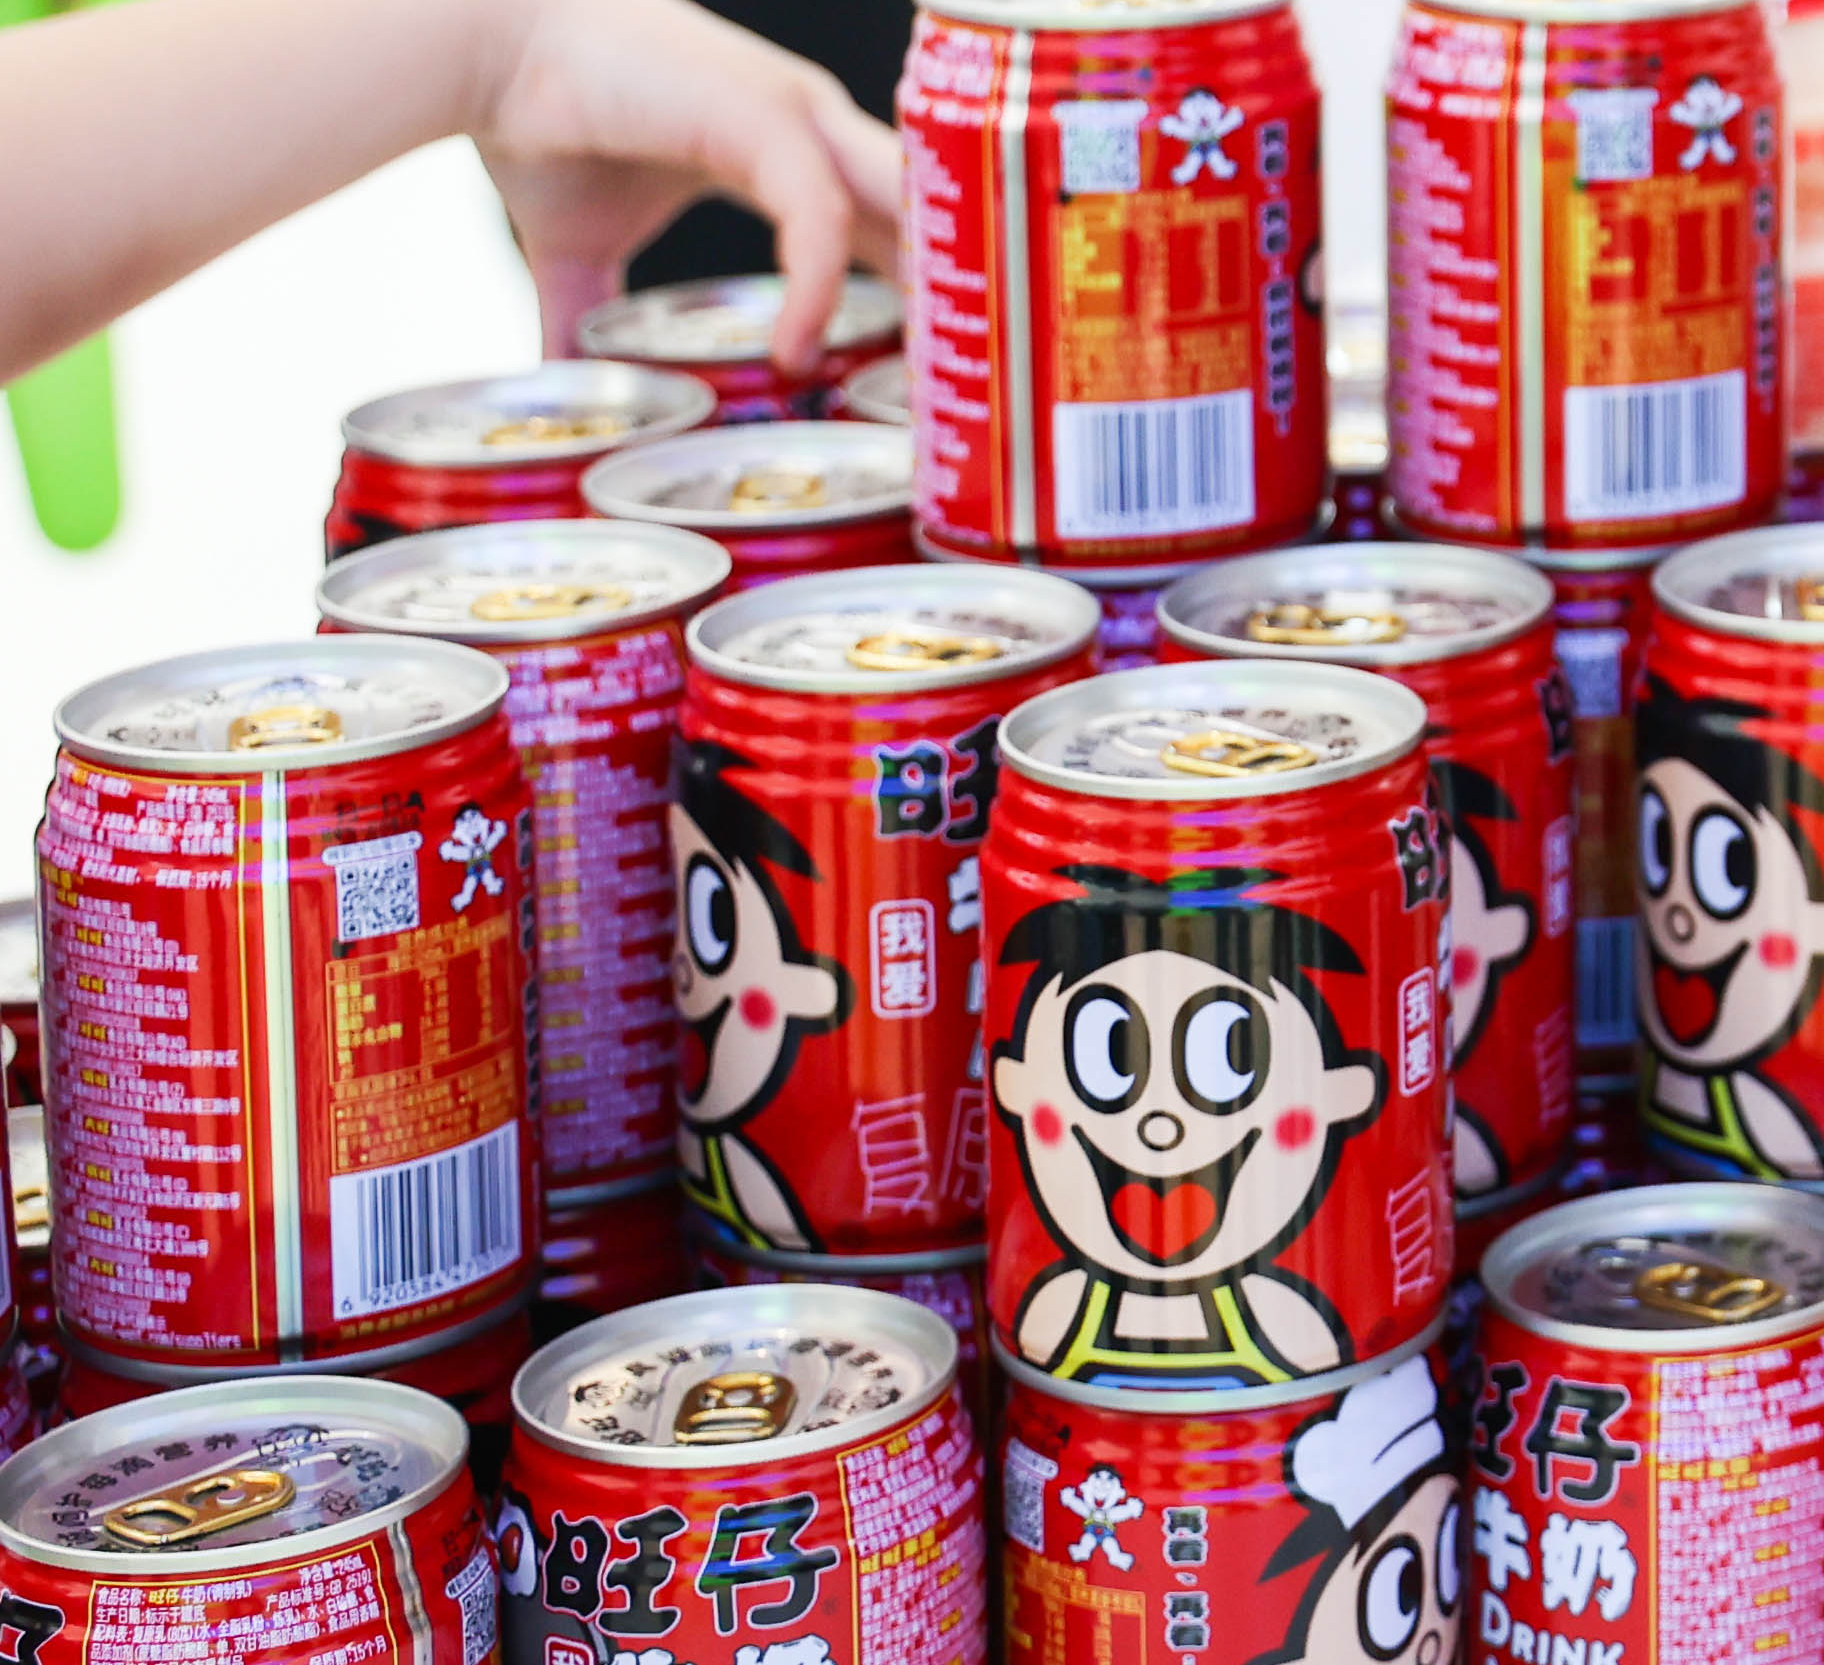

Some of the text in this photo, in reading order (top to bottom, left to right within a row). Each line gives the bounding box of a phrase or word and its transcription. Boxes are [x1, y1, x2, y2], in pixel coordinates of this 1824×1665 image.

[542, 1492, 841, 1638] 旺仔
[1473, 1486, 1638, 1622] 牛奶
[1480, 1589, 1626, 1665] DRINK
